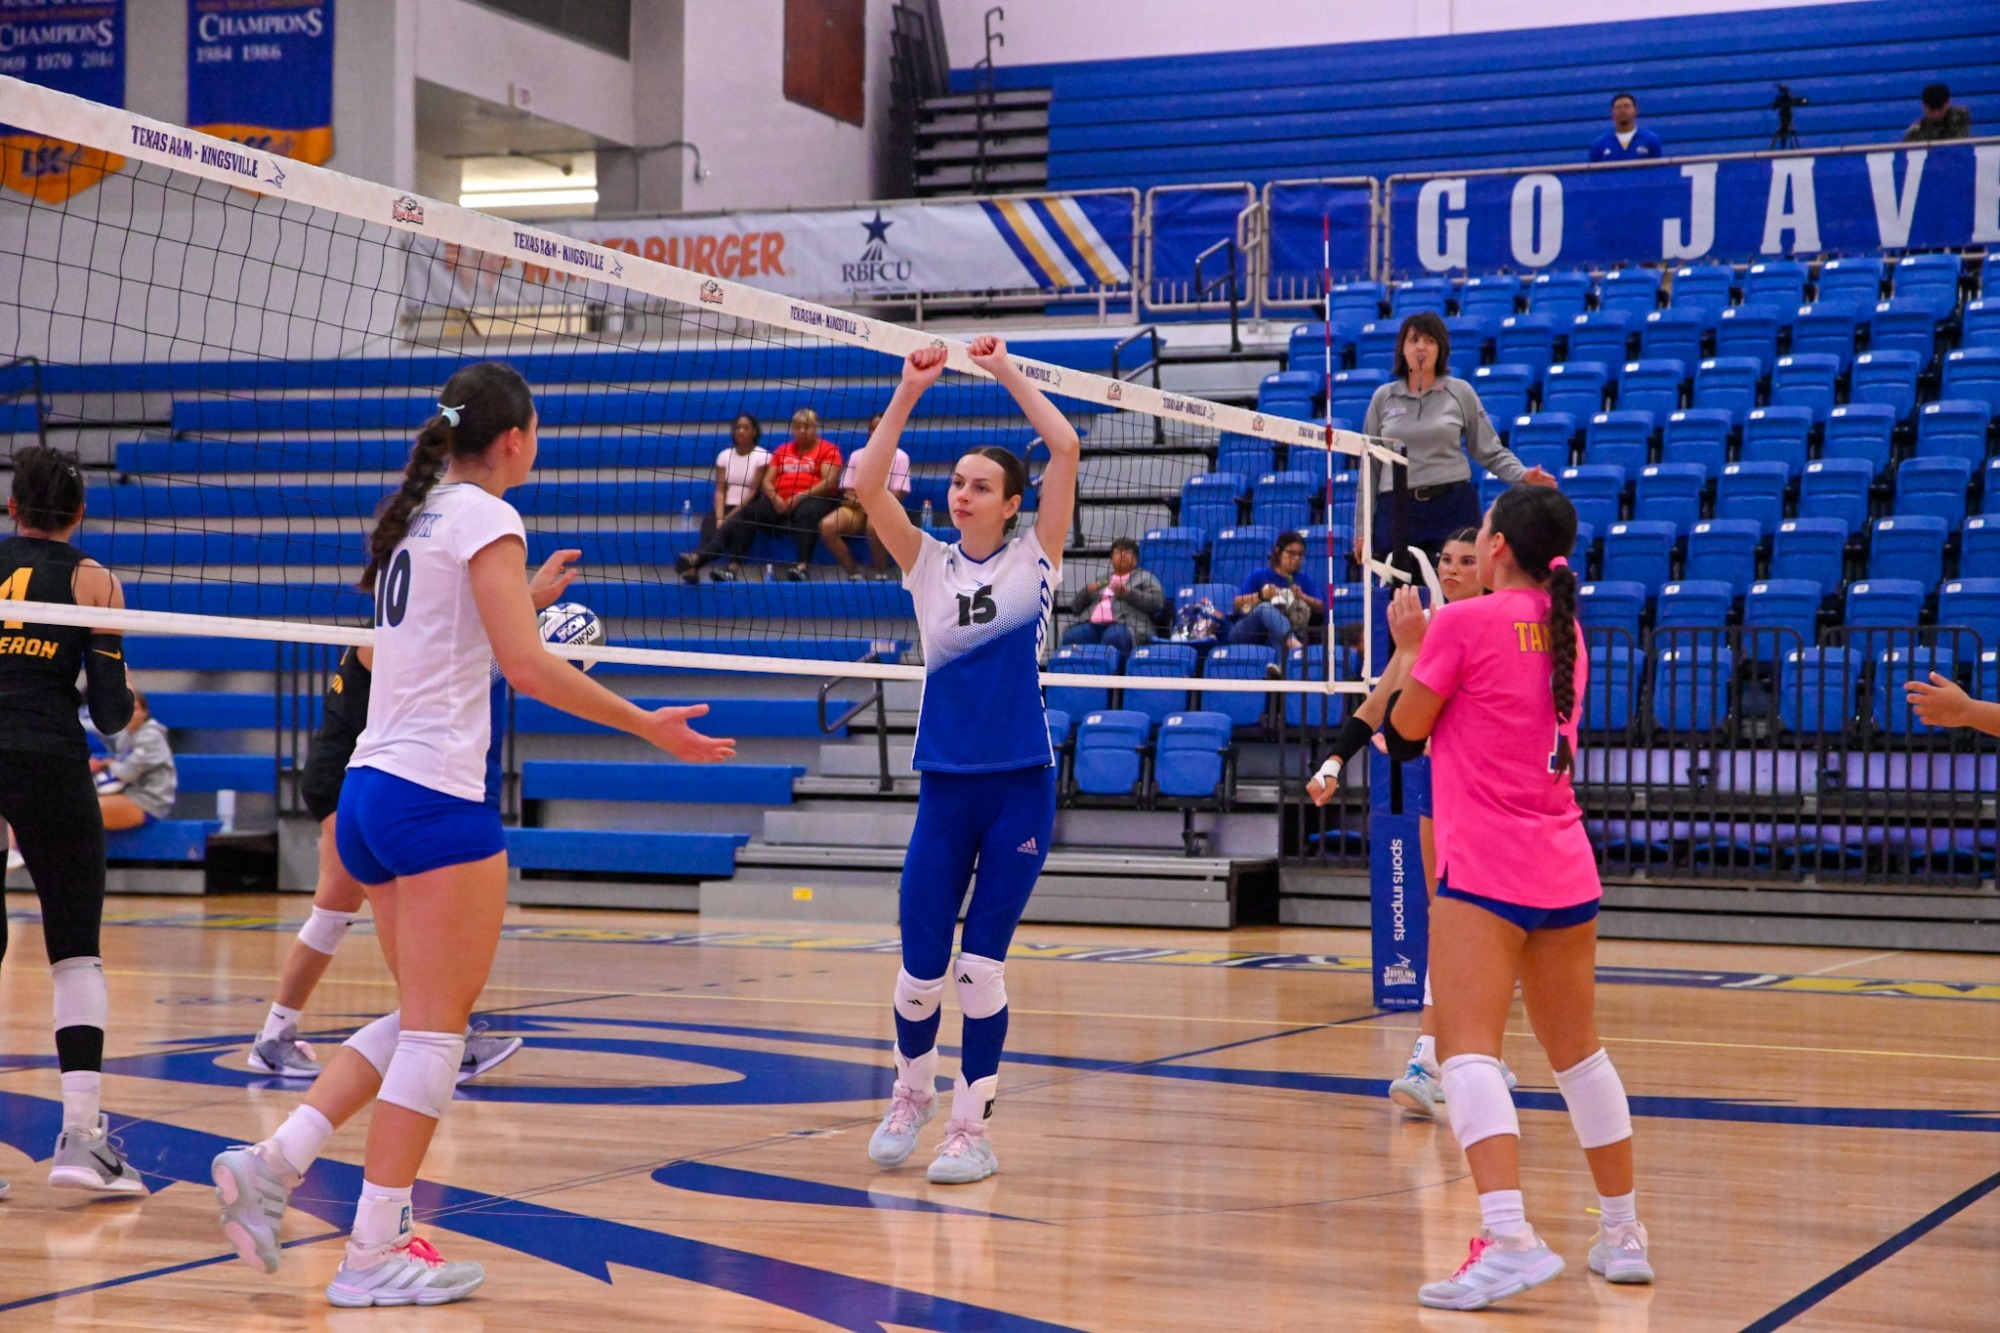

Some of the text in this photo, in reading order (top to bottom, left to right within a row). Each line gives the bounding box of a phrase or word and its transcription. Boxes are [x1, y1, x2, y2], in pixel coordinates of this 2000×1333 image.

[199, 8, 323, 41] CHAMPIONS
[131, 125, 168, 153] TEXAS
[169, 136, 193, 160] A&M
[200, 145, 258, 178] KINGSVILLE
[513, 231, 540, 254] TEXAS
[1417, 173, 1563, 272] GO
[842, 260, 912, 282] RBFCU
[376, 549, 411, 627] 10
[955, 584, 997, 627] 15
[1390, 838, 1406, 942] sports imports
